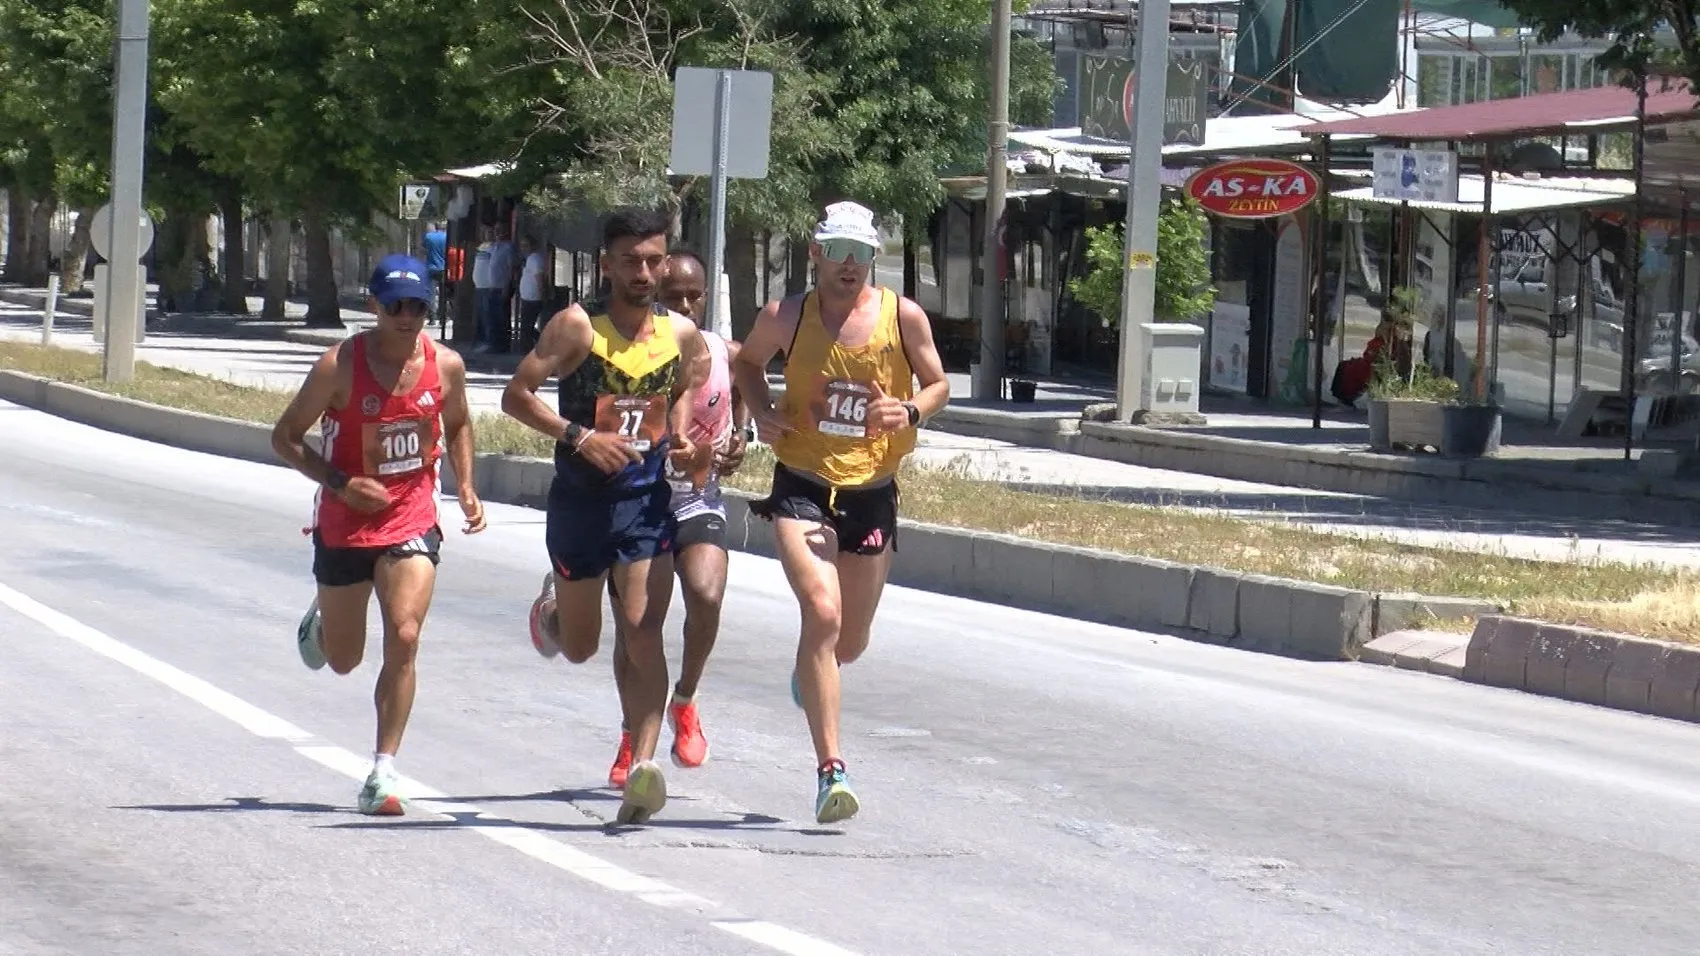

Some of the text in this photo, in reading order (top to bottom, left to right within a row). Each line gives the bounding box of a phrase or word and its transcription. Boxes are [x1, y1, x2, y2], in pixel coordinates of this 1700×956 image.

[1202, 176, 1308, 197] AS-KA
[826, 393, 868, 423] 146
[618, 409, 645, 440] 27
[381, 431, 420, 459] 100
